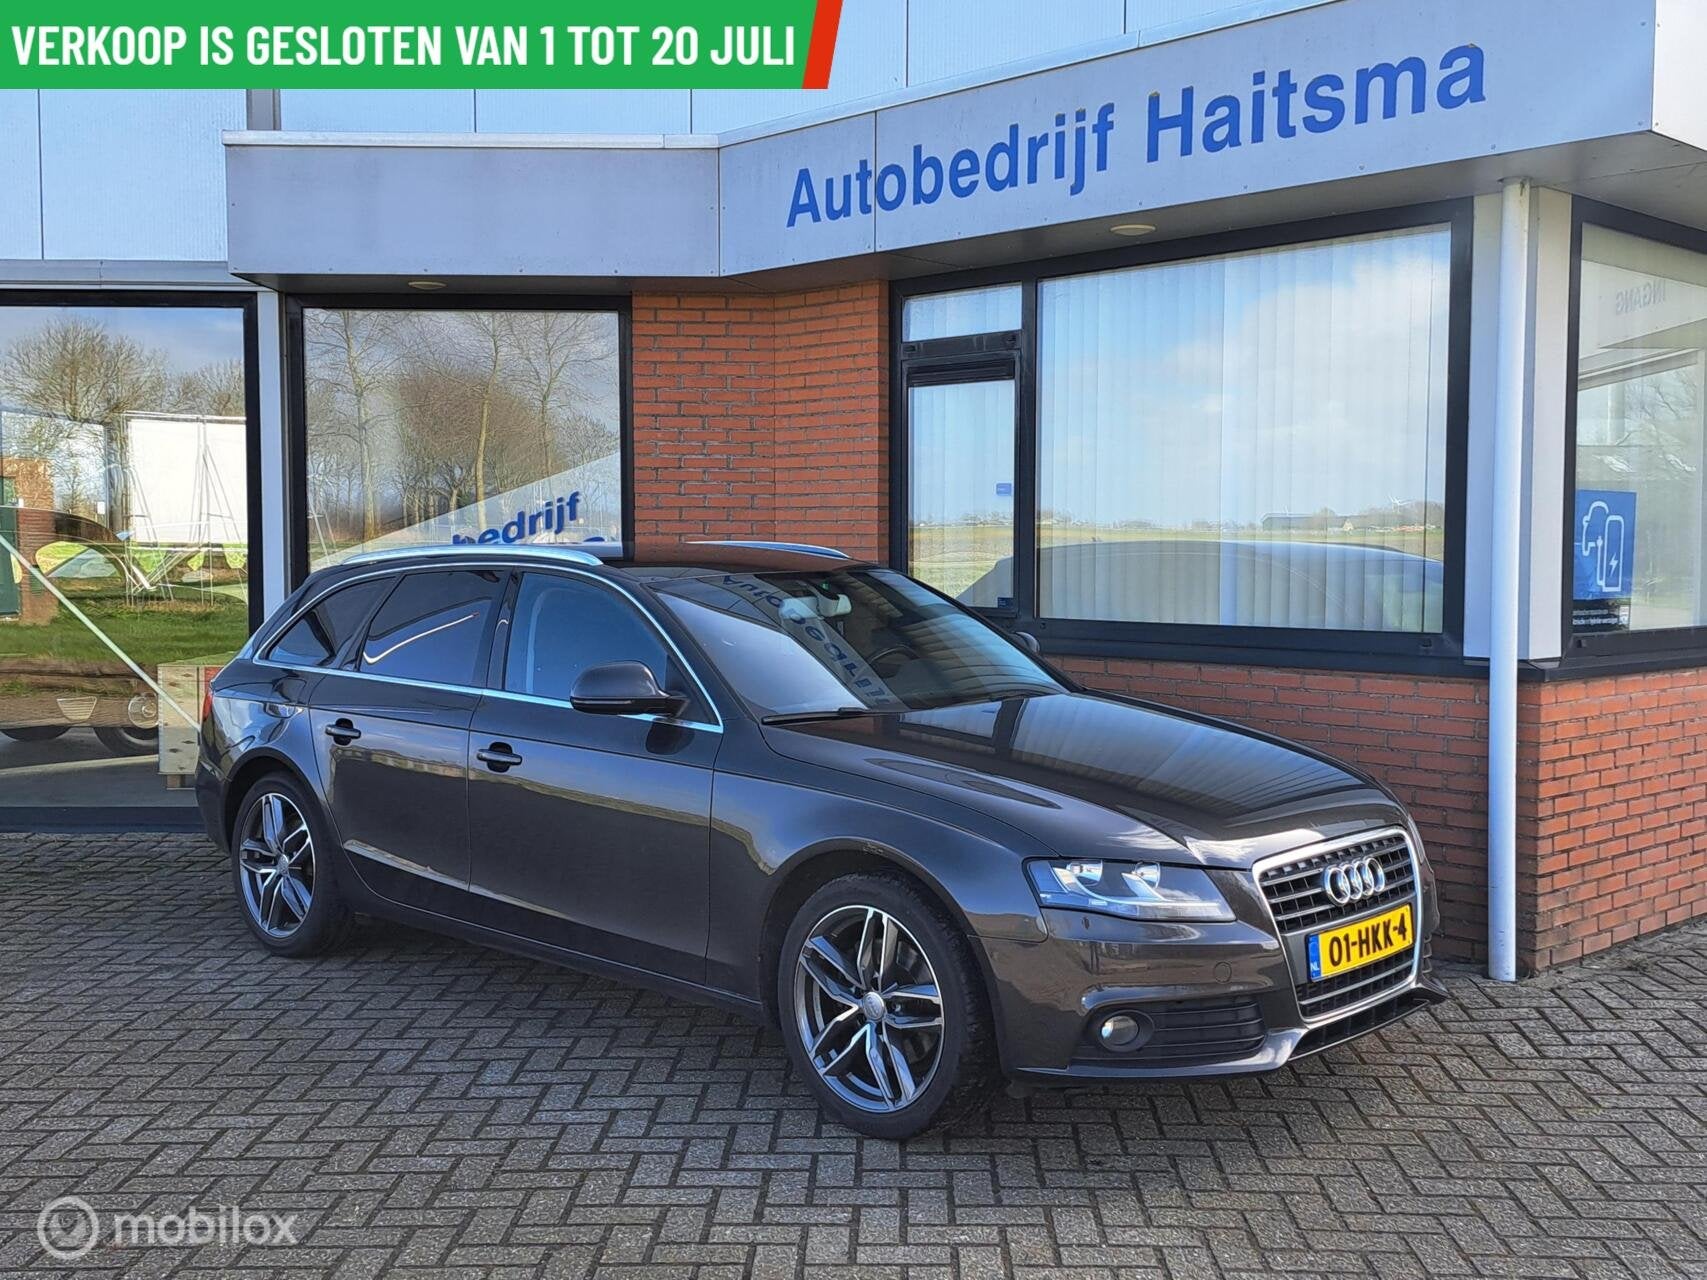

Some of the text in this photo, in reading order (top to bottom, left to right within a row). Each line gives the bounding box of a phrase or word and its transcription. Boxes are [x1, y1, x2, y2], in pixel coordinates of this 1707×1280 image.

[786, 43, 1486, 228] Autobedrijf Haitsma
[1310, 961, 1320, 971] NL
[1328, 912, 1408, 968] 01-HKK-4
